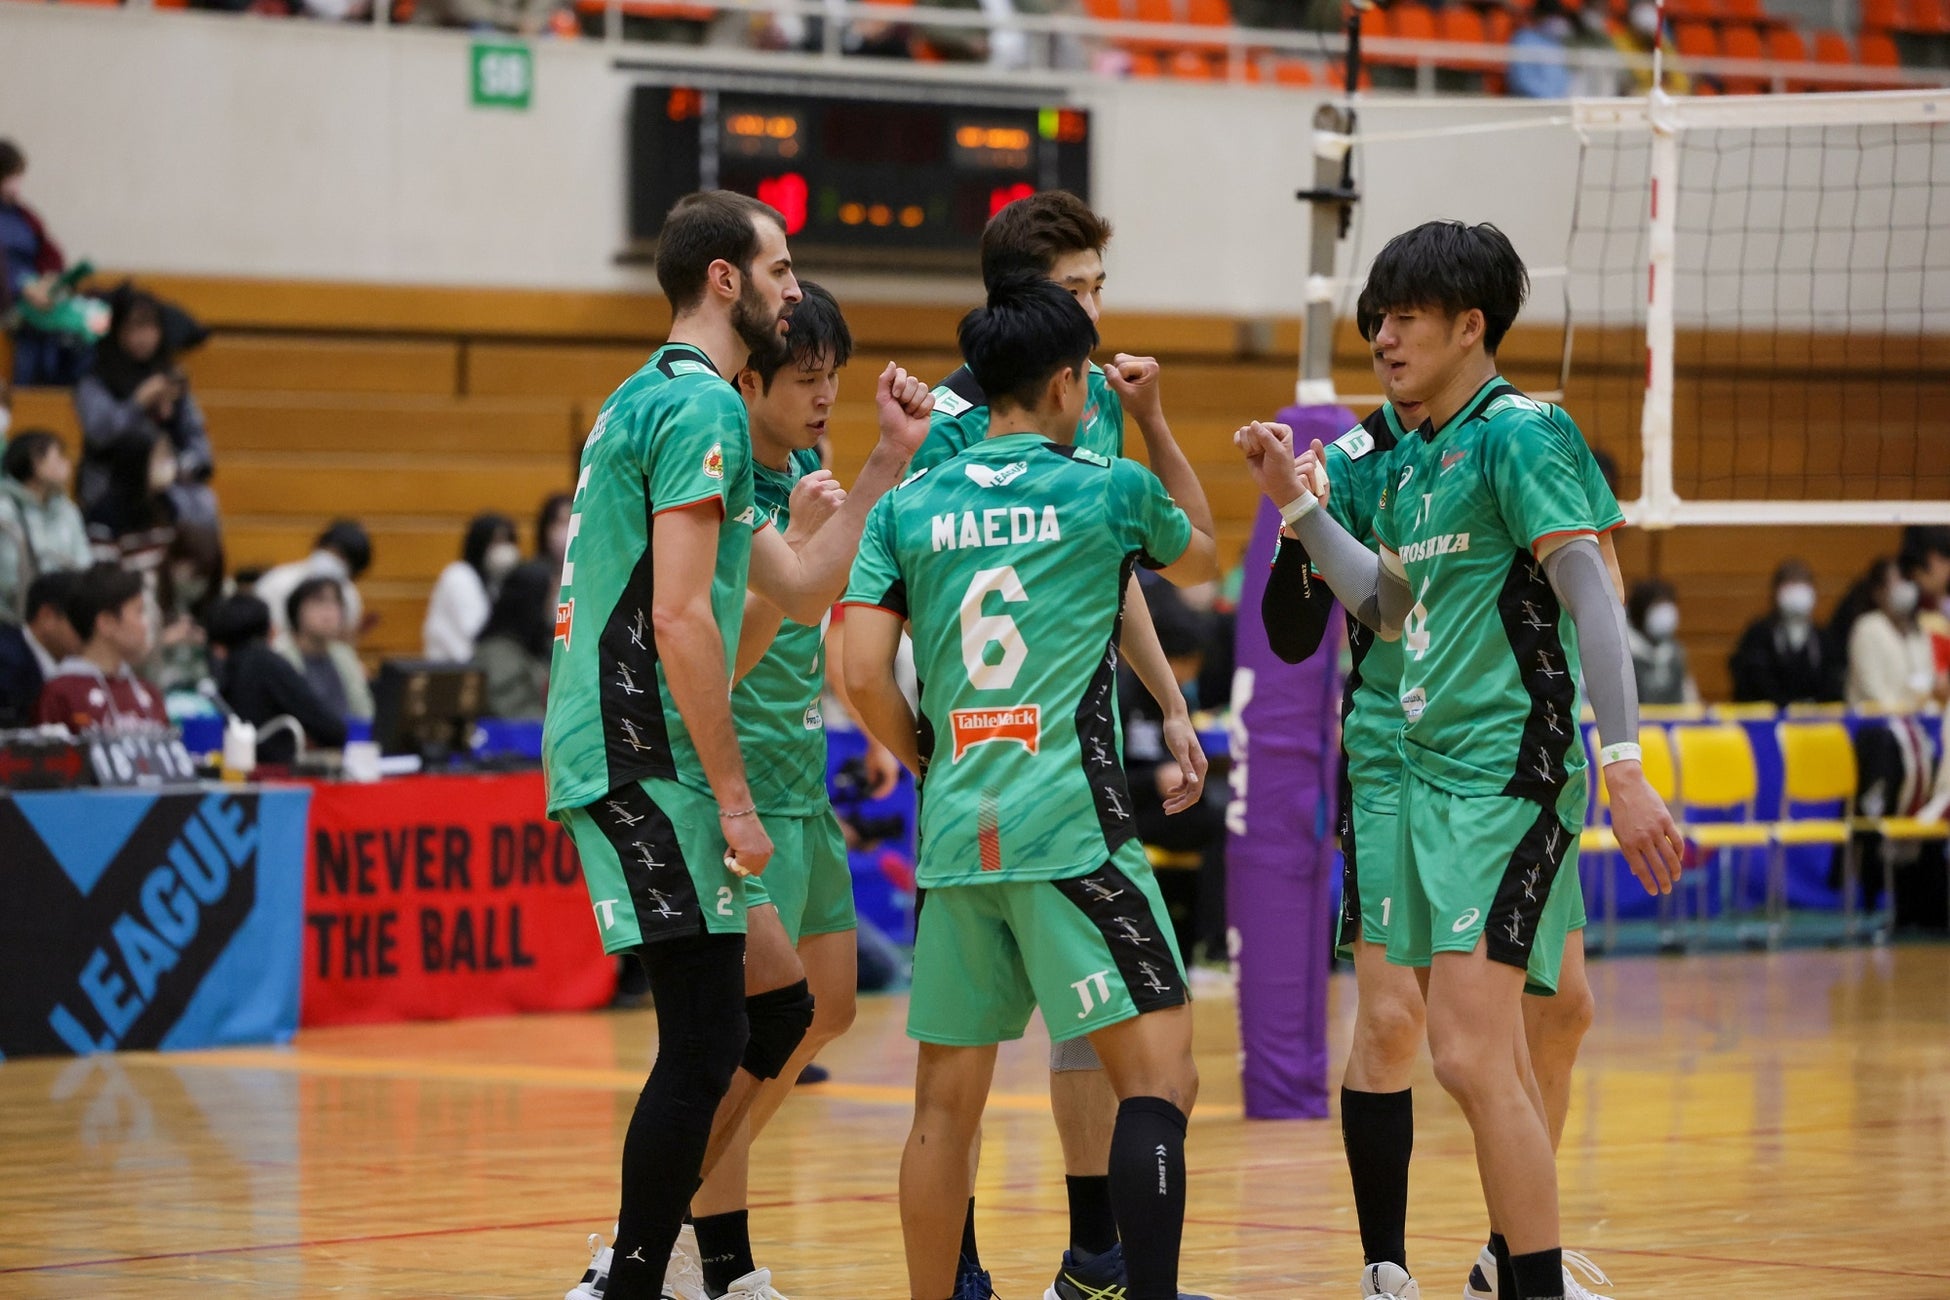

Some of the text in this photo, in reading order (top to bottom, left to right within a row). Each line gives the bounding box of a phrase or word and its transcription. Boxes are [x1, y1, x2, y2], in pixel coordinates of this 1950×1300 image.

[931, 504, 1061, 553] MAEDA
[959, 564, 1030, 692] 6
[1405, 575, 1431, 662] 4
[955, 710, 1035, 730] TableMark
[314, 825, 472, 896] NEVER
[48, 792, 257, 1055] LEAGUE
[716, 886, 734, 916] 2
[307, 904, 535, 979] THE BALL
[1070, 969, 1112, 1020] JT
